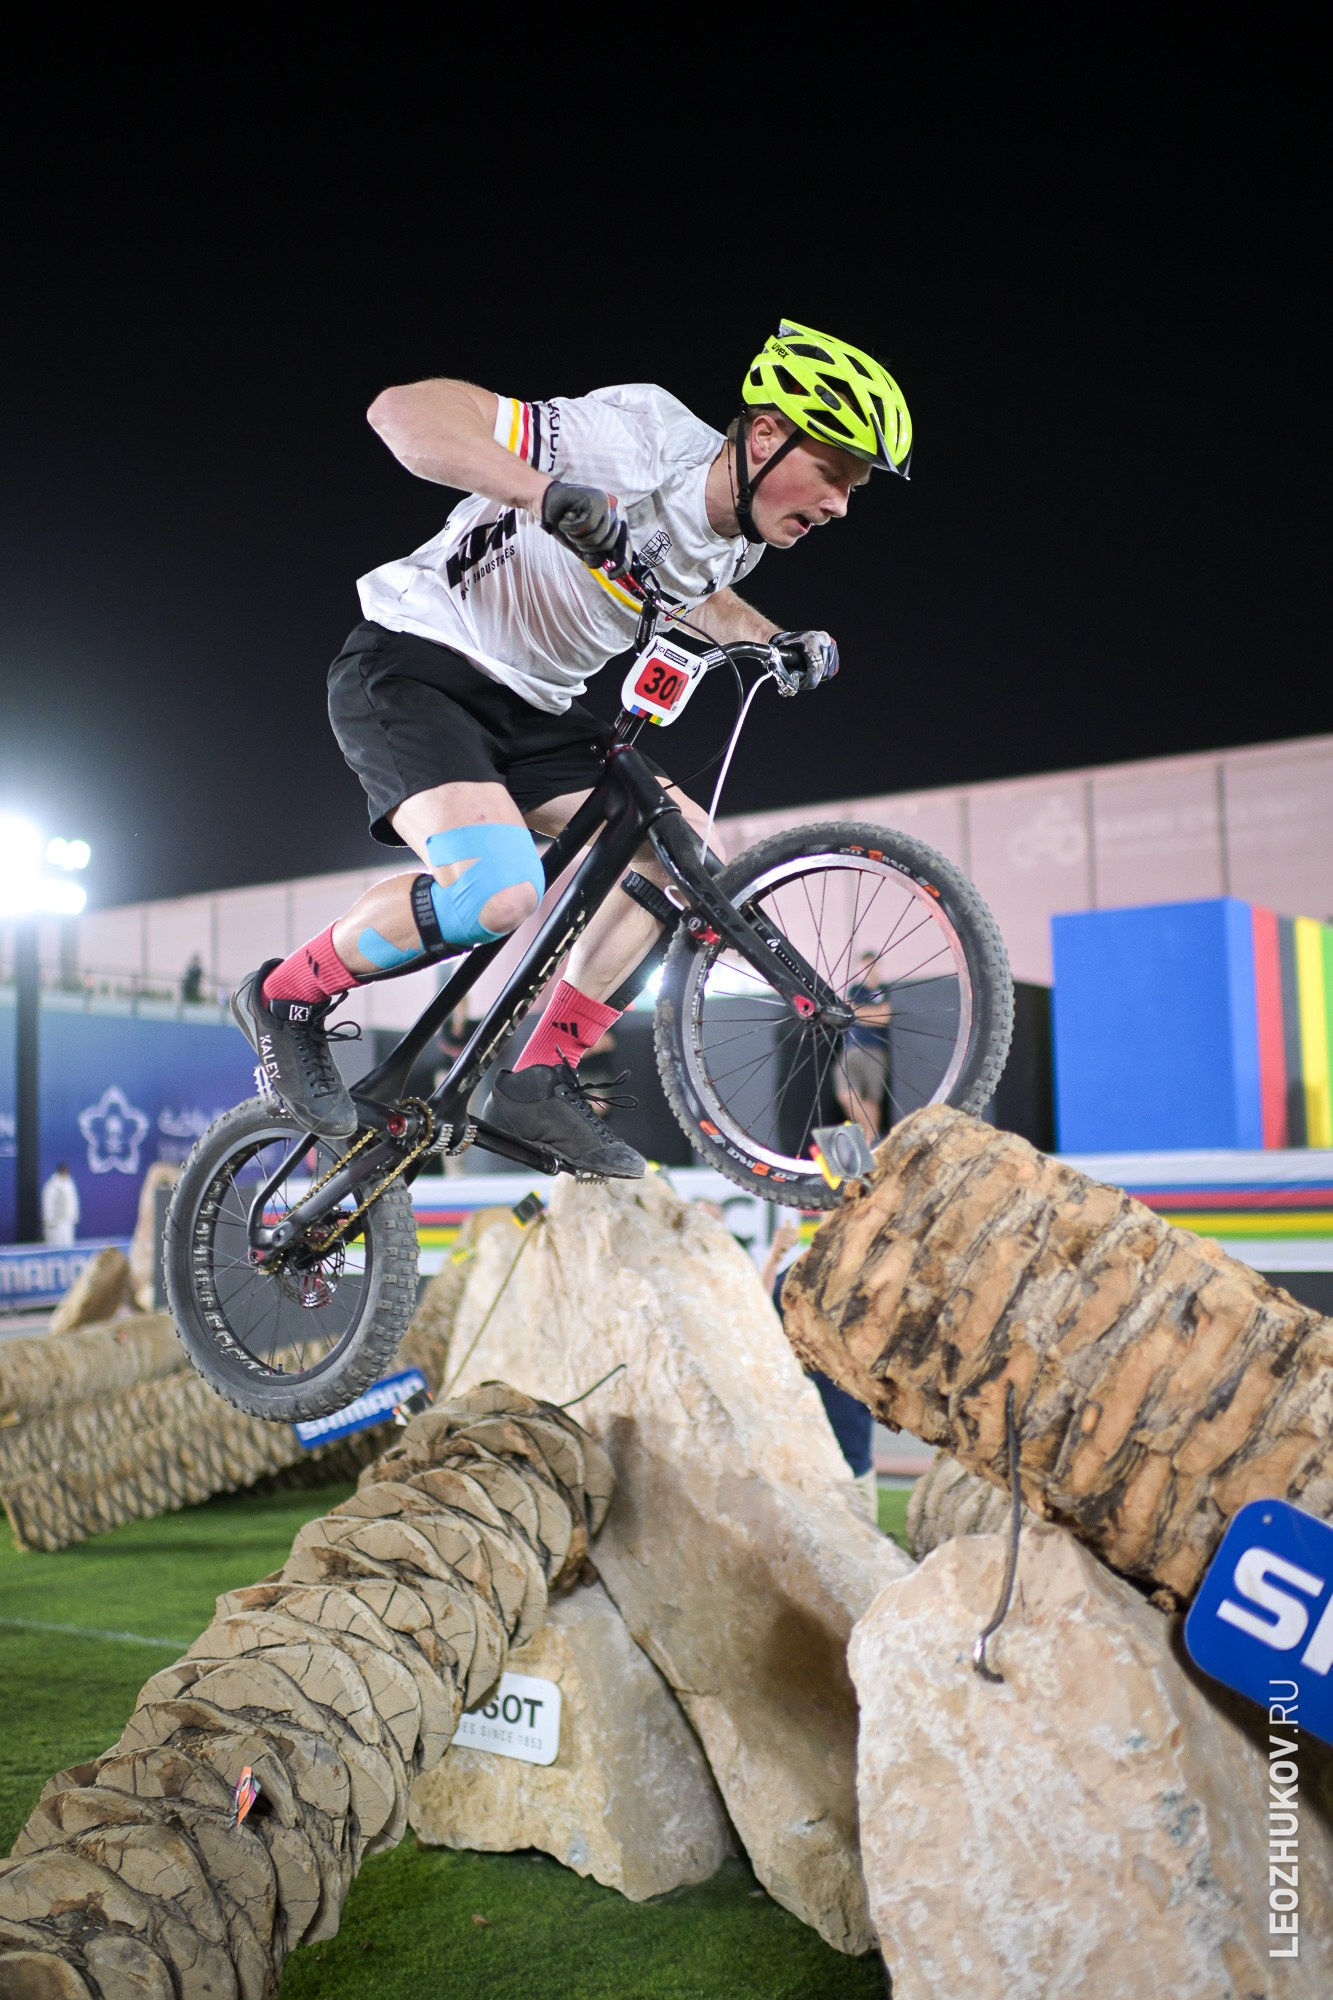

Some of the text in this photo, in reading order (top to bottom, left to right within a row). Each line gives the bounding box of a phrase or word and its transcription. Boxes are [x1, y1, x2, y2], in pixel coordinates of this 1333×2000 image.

[643, 666, 683, 704] 301
[260, 1034, 281, 1079] KALEY
[1216, 1547, 1333, 1677] S
[466, 1694, 544, 1729] SOT
